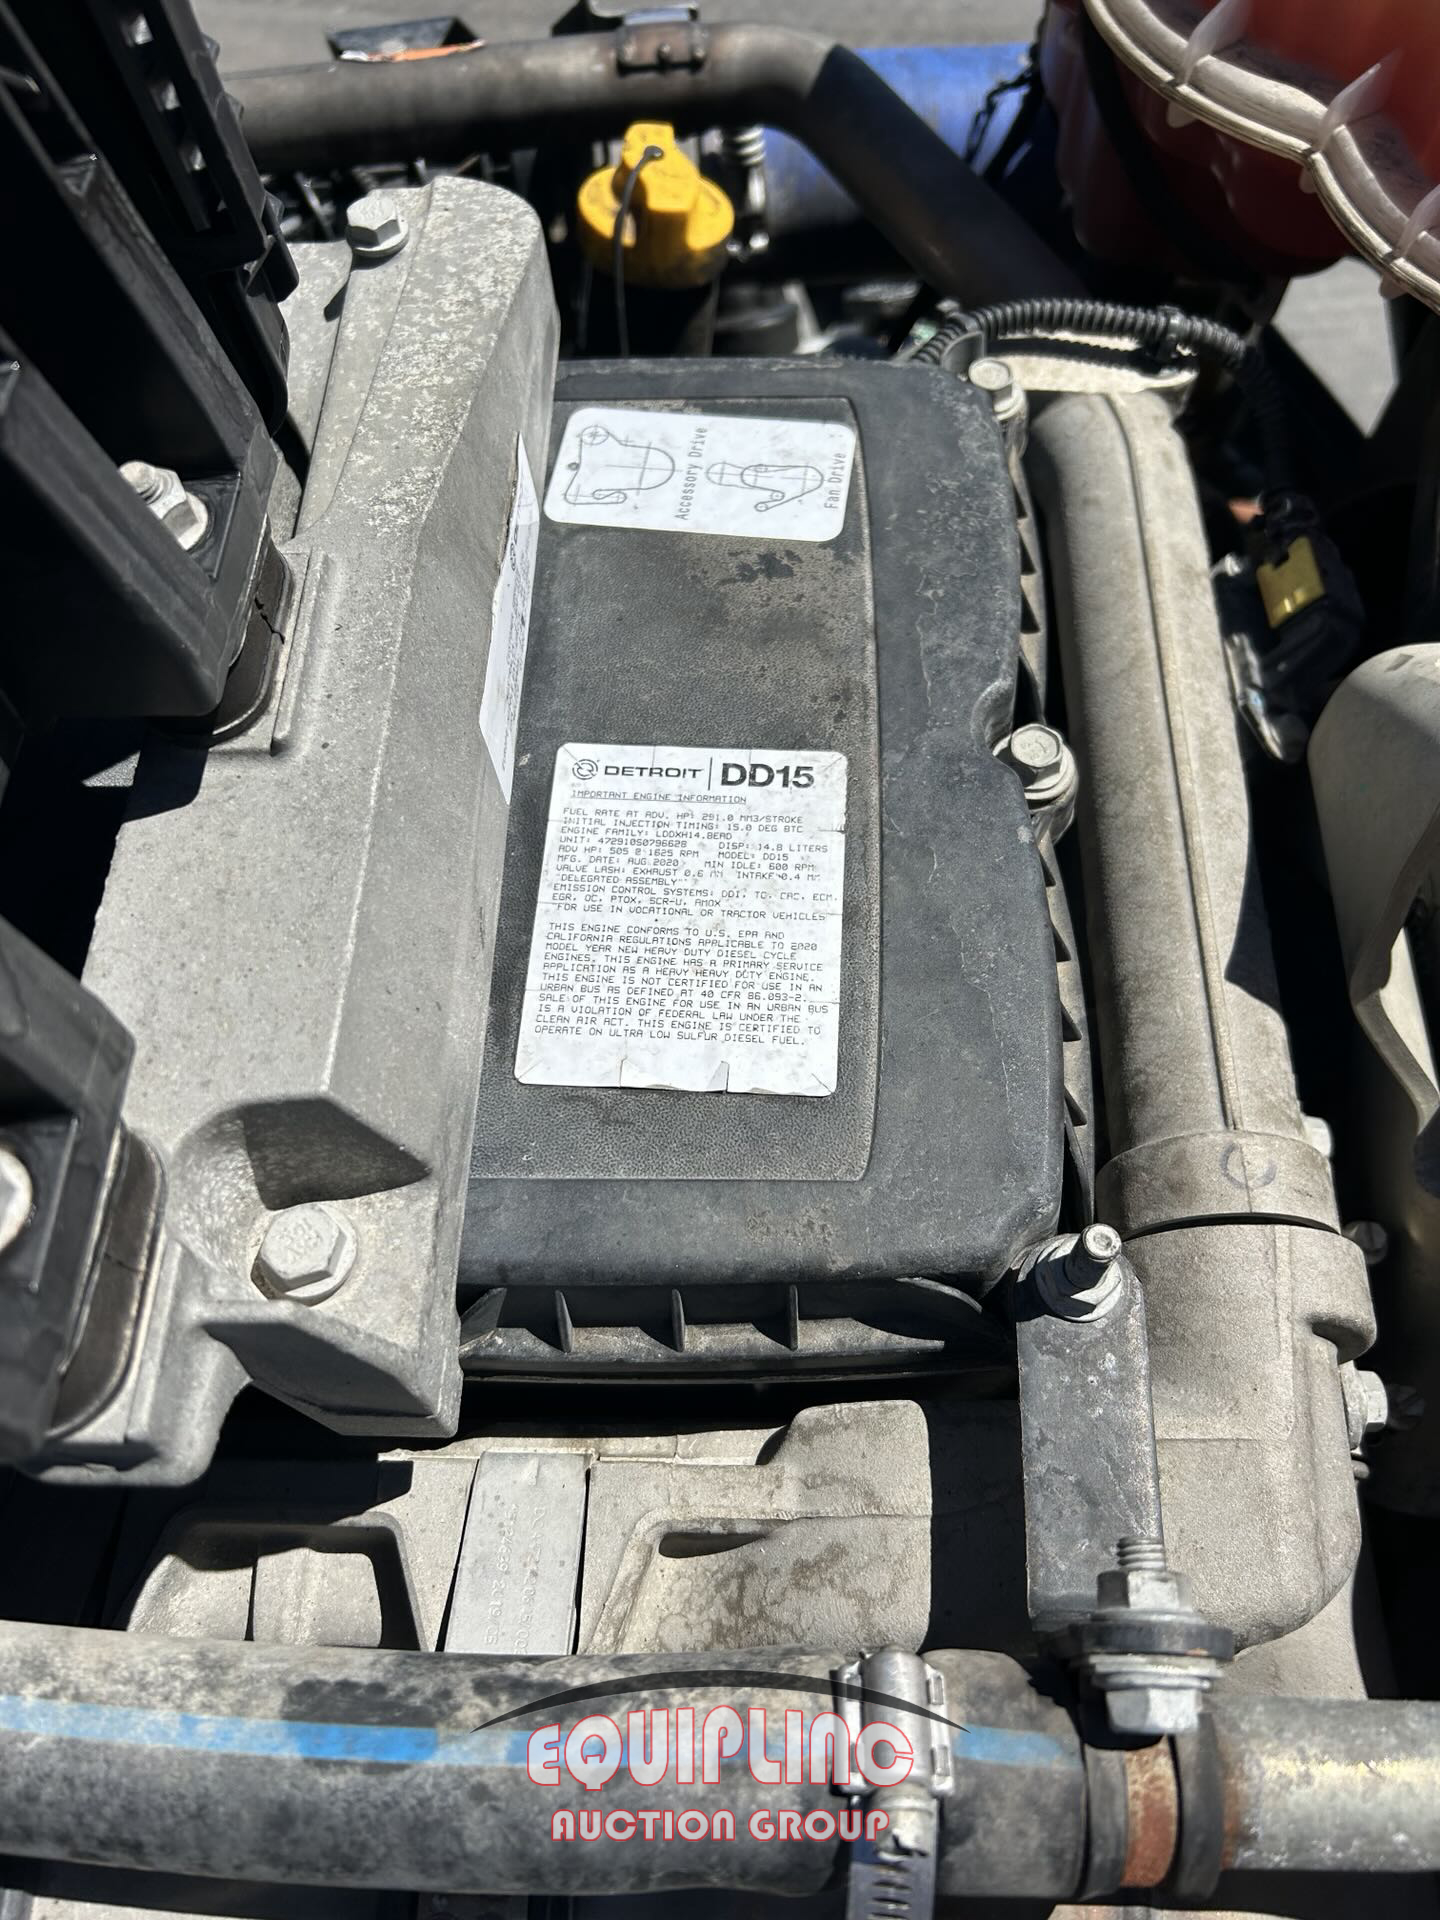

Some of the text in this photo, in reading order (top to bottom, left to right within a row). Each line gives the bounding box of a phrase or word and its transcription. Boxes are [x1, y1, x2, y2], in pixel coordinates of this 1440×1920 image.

[675, 427, 708, 520] Accessory Drive
[824, 452, 847, 510] Fan Drive
[604, 763, 815, 788] DETROIT DD15
[571, 790, 746, 803] IMPORTANT ENGINE INFORMATION
[562, 808, 588, 816] FUEL
[594, 809, 620, 818] RATE
[625, 810, 638, 818] AT
[644, 810, 669, 819] ADV.
[675, 812, 694, 820] HP:
[559, 826, 599, 835] ENGINE
[604, 828, 648, 837] FAMILY:
[561, 817, 804, 833] INITIAL INJECTION TIMING: 15.0 DEG BTC
[557, 845, 578, 854] ADV
[583, 846, 602, 855] HP:
[609, 847, 629, 856] 505
[648, 848, 673, 857] 1625
[679, 850, 699, 858] RPM
[717, 851, 755, 861] MODEL:
[762, 853, 789, 862] DD15
[558, 836, 828, 853] UNIT: DISP: 14.8 LITERS
[555, 864, 588, 873] VALVE
[594, 866, 625, 875] LASH:
[632, 867, 677, 877] EXHAUST
[683, 869, 704, 878] 0.6
[556, 854, 816, 872] MFG. DATE: AUG 2020 MIN IDLE: 600 RPM
[553, 883, 605, 893] EMISSION
[611, 885, 656, 895] CONTROL
[663, 887, 714, 897] SYSTEMS:
[582, 904, 603, 913] USE
[610, 905, 622, 913] IN
[628, 906, 694, 916] VOCATIONAL
[700, 908, 714, 917] OR
[720, 909, 766, 919] TRACTOR
[694, 898, 721, 907] AMOX
[548, 922, 784, 940] THIS ENGINE CONFORMS TO U.S. EPA AND
[546, 932, 817, 950] CALIFORNIA REGULATIONS APPLICABLE TO 2020
[544, 942, 797, 960] MODEL YEAR NEW HEAVY DUTY DIESEL CYCLE
[543, 952, 823, 971] ENGINES. THIS ENGINE HAS A PRIMARY SERVICE
[542, 962, 814, 981] APPLICATION AS A HEAVY HEAVY DUTY ENGINE.
[539, 983, 574, 993] URBAN
[580, 985, 600, 994] BUS
[606, 986, 620, 994] AS
[626, 987, 674, 996] DEFINED
[680, 989, 692, 997] AT
[700, 990, 714, 998] 40
[720, 990, 741, 999] CFR
[542, 973, 822, 991] THIS ENGINE IS NOT CERTIFIED FOR USE IN AN
[538, 994, 828, 1013] SALE OF THIS ENGINE FOR USE IN AN URBAN BUS
[538, 1004, 800, 1023] IS A VIOLATION OF FEDERAL LAW UNDER THE
[535, 1014, 821, 1035] CLEAN AIR ACT. THIS ENGINE IS CERTIFIED TO
[534, 1025, 804, 1045] OPERATE ON ULTRA LOW SULFUR DIESEL FUEL.
